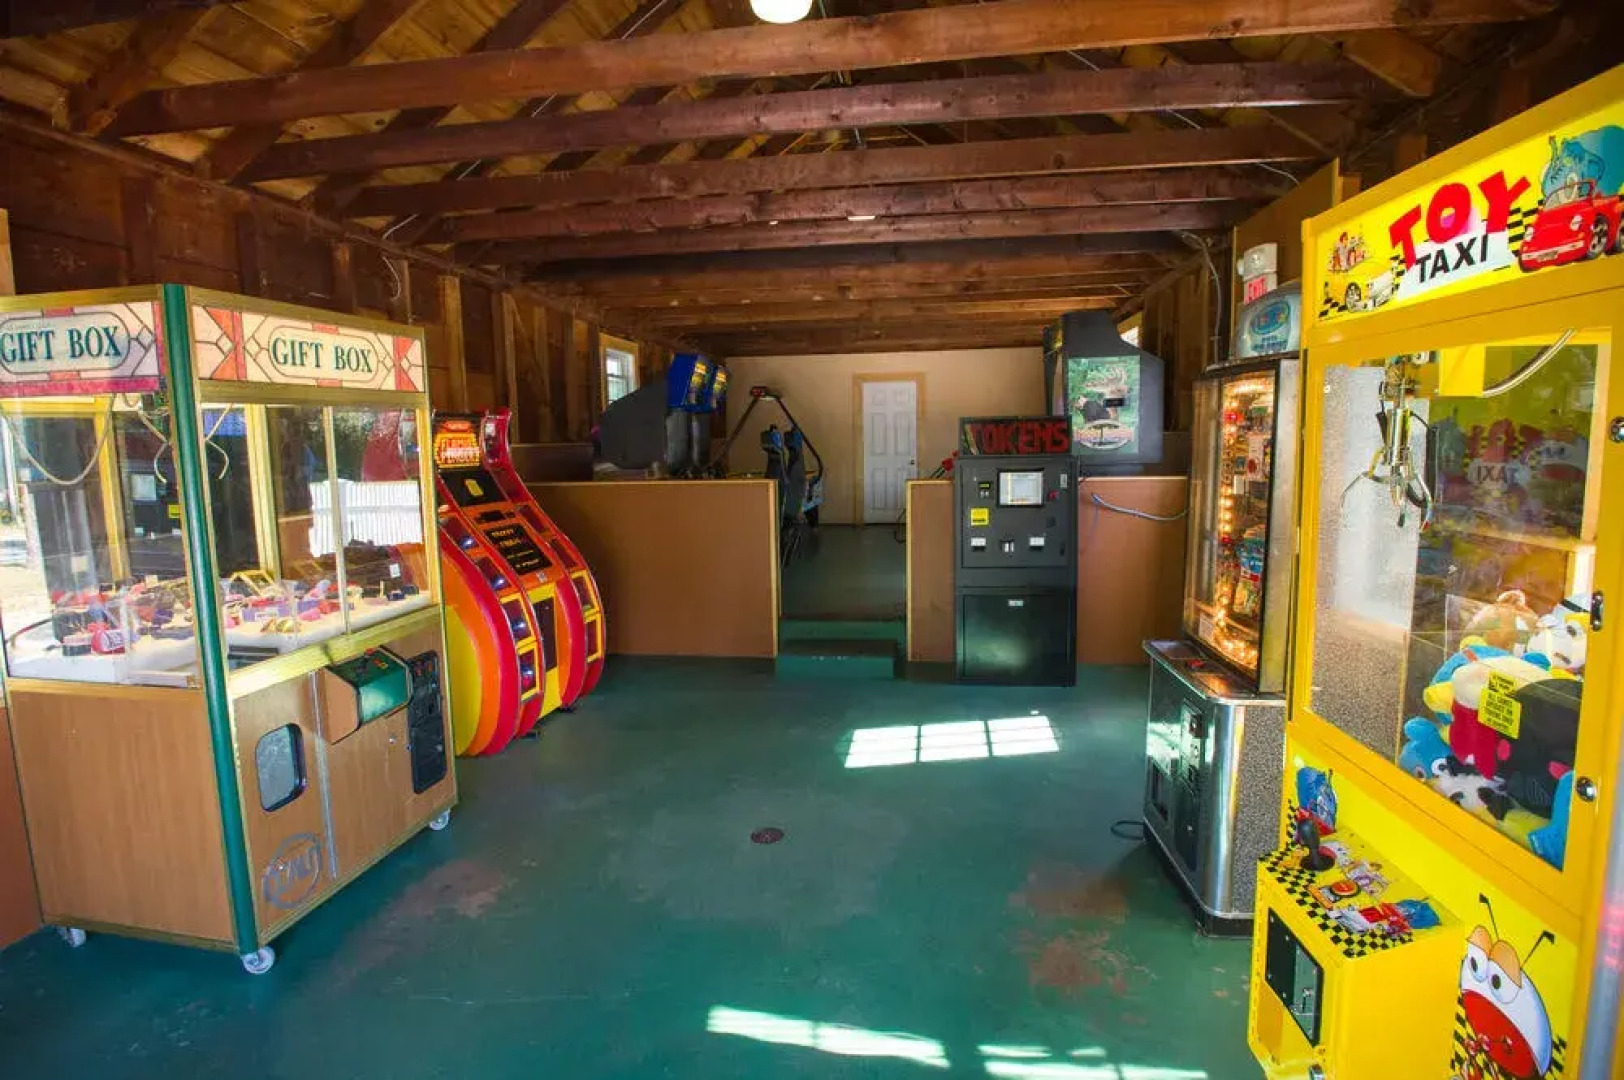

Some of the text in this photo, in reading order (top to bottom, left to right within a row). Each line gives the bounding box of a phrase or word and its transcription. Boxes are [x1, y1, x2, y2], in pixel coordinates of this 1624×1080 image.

[1389, 170, 1531, 271] TOY
[1415, 234, 1489, 283] TAXI
[1, 325, 121, 363] GIFT BOX
[272, 337, 373, 374] GIFT BOX
[963, 420, 1070, 455] TOKENS
